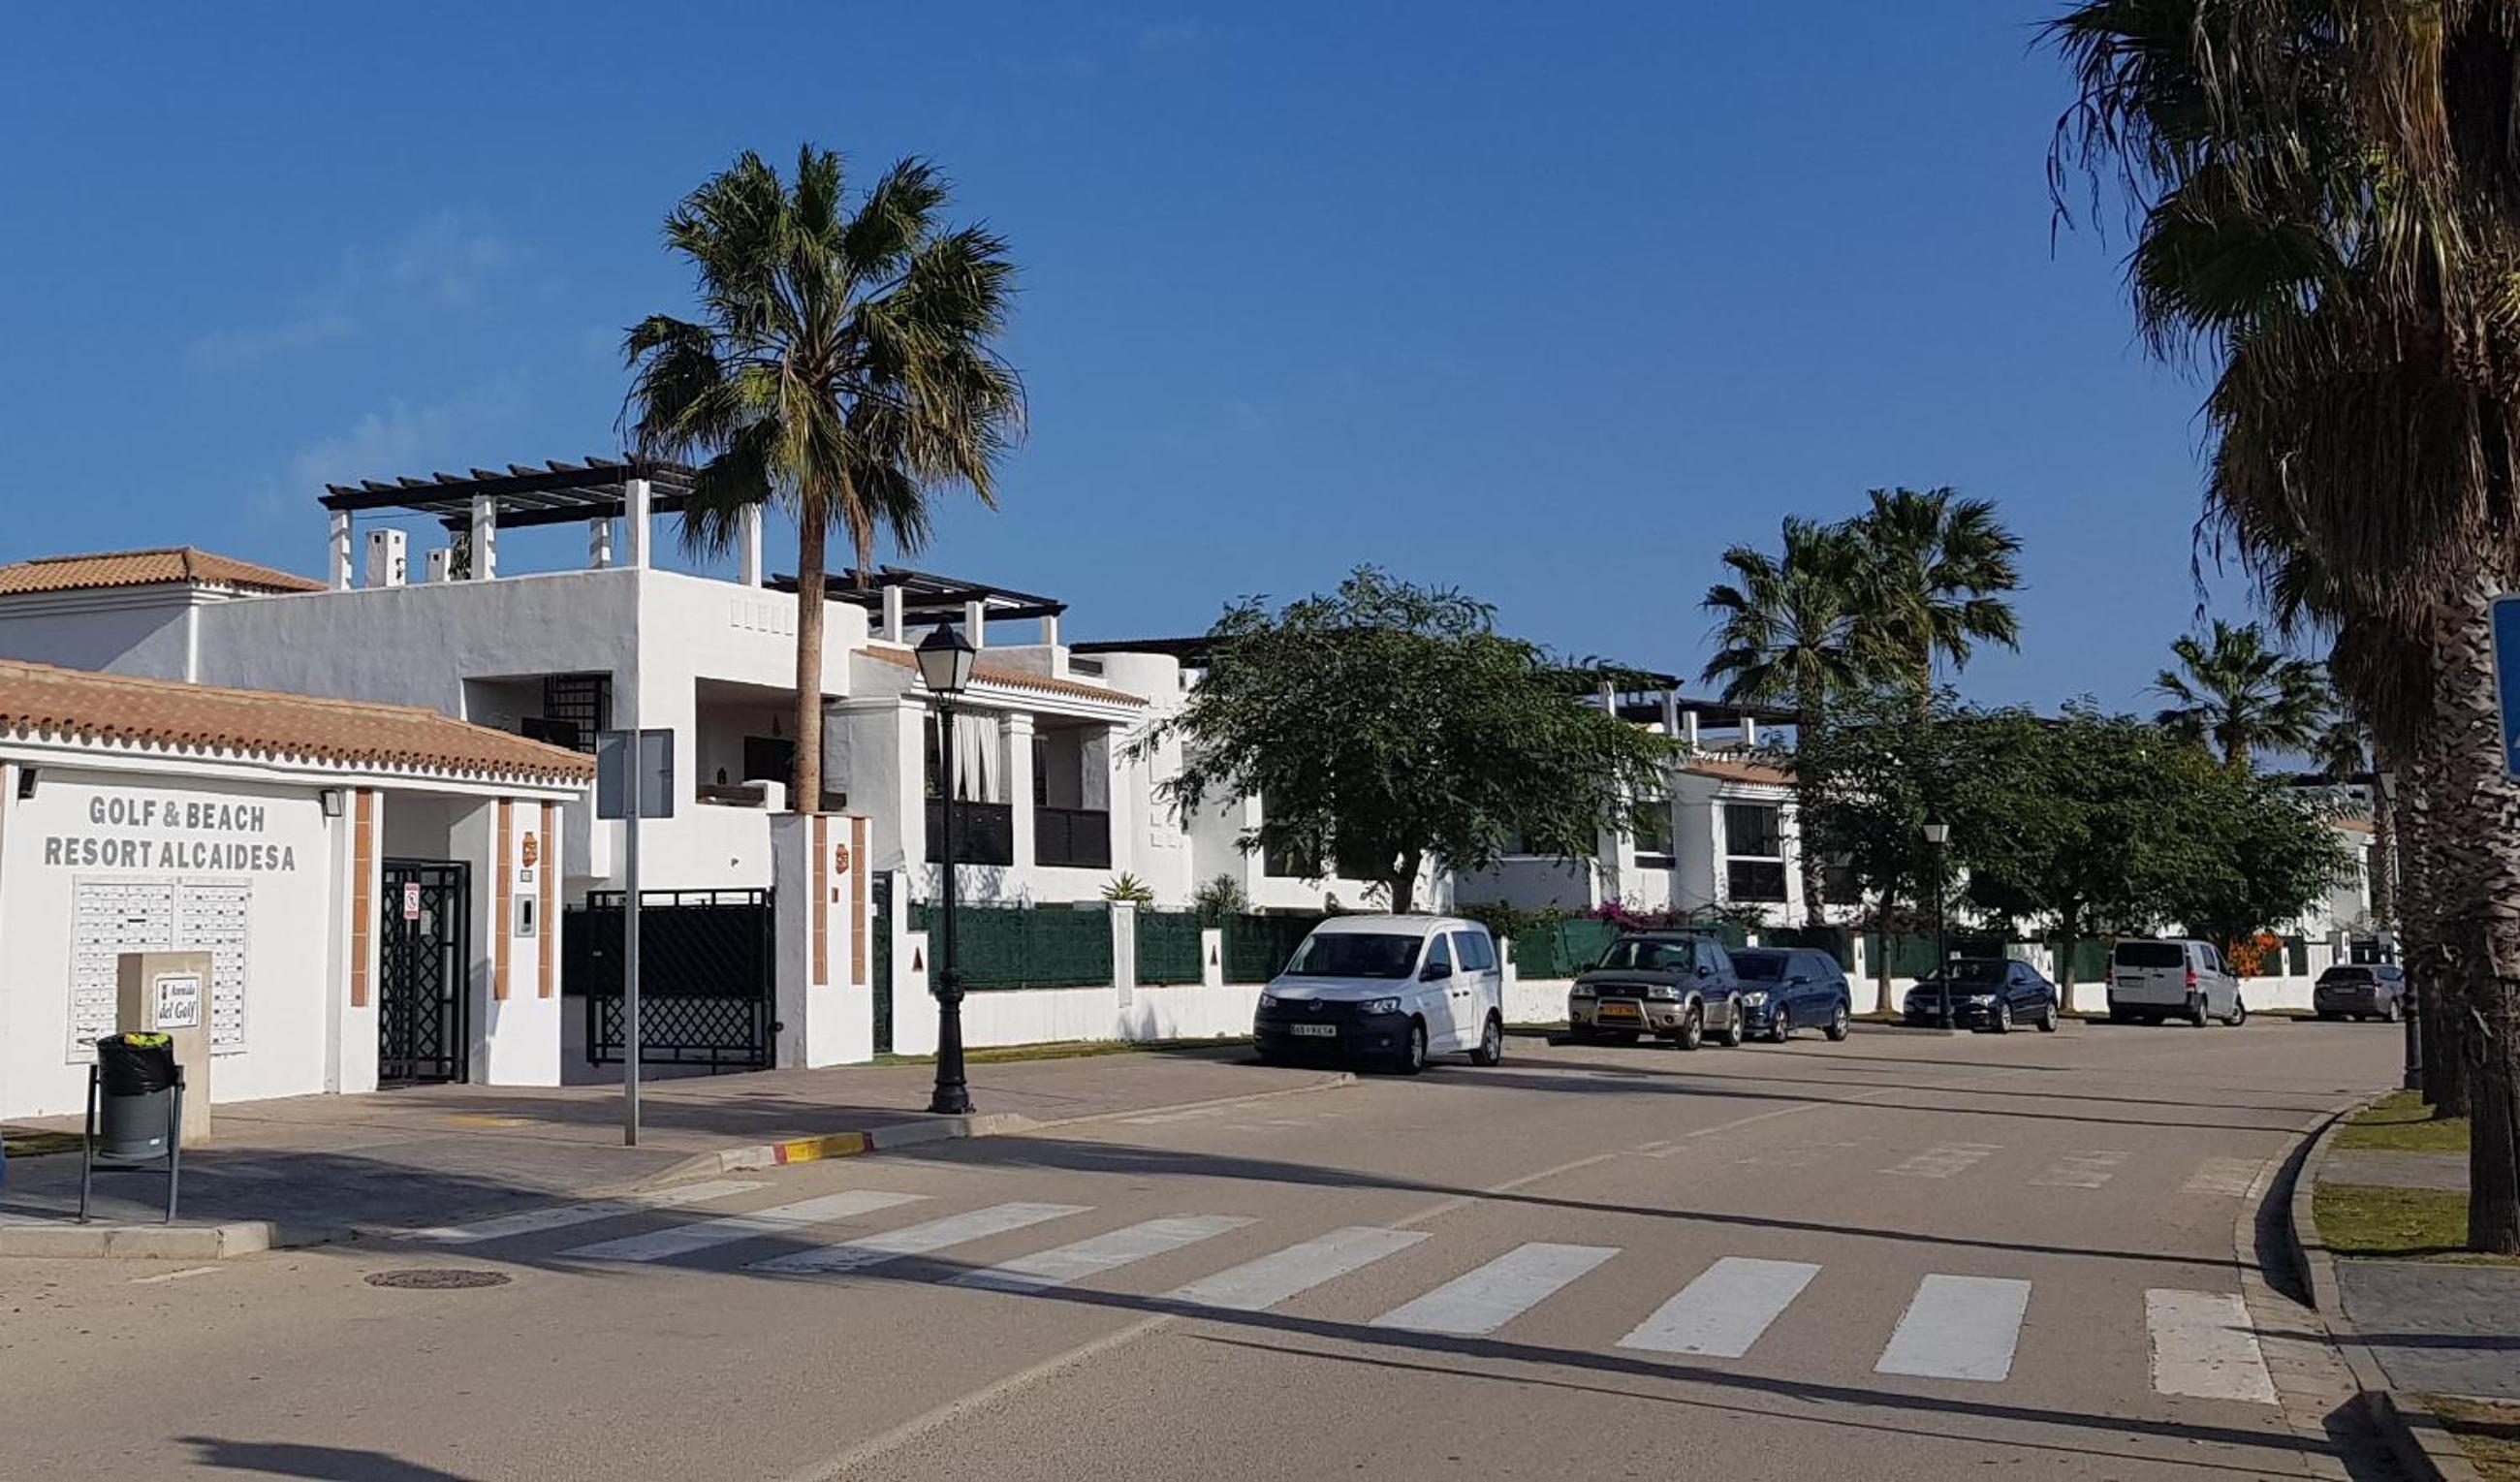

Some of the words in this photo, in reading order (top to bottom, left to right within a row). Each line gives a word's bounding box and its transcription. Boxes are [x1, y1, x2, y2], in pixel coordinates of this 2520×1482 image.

[89, 796, 156, 827] GOLF
[163, 801, 181, 827] &
[186, 803, 265, 832] BEACH
[45, 836, 152, 867] RESORT
[159, 841, 296, 871] ALCAIDESA
[159, 1001, 173, 1019] del
[174, 1001, 197, 1024] Golf
